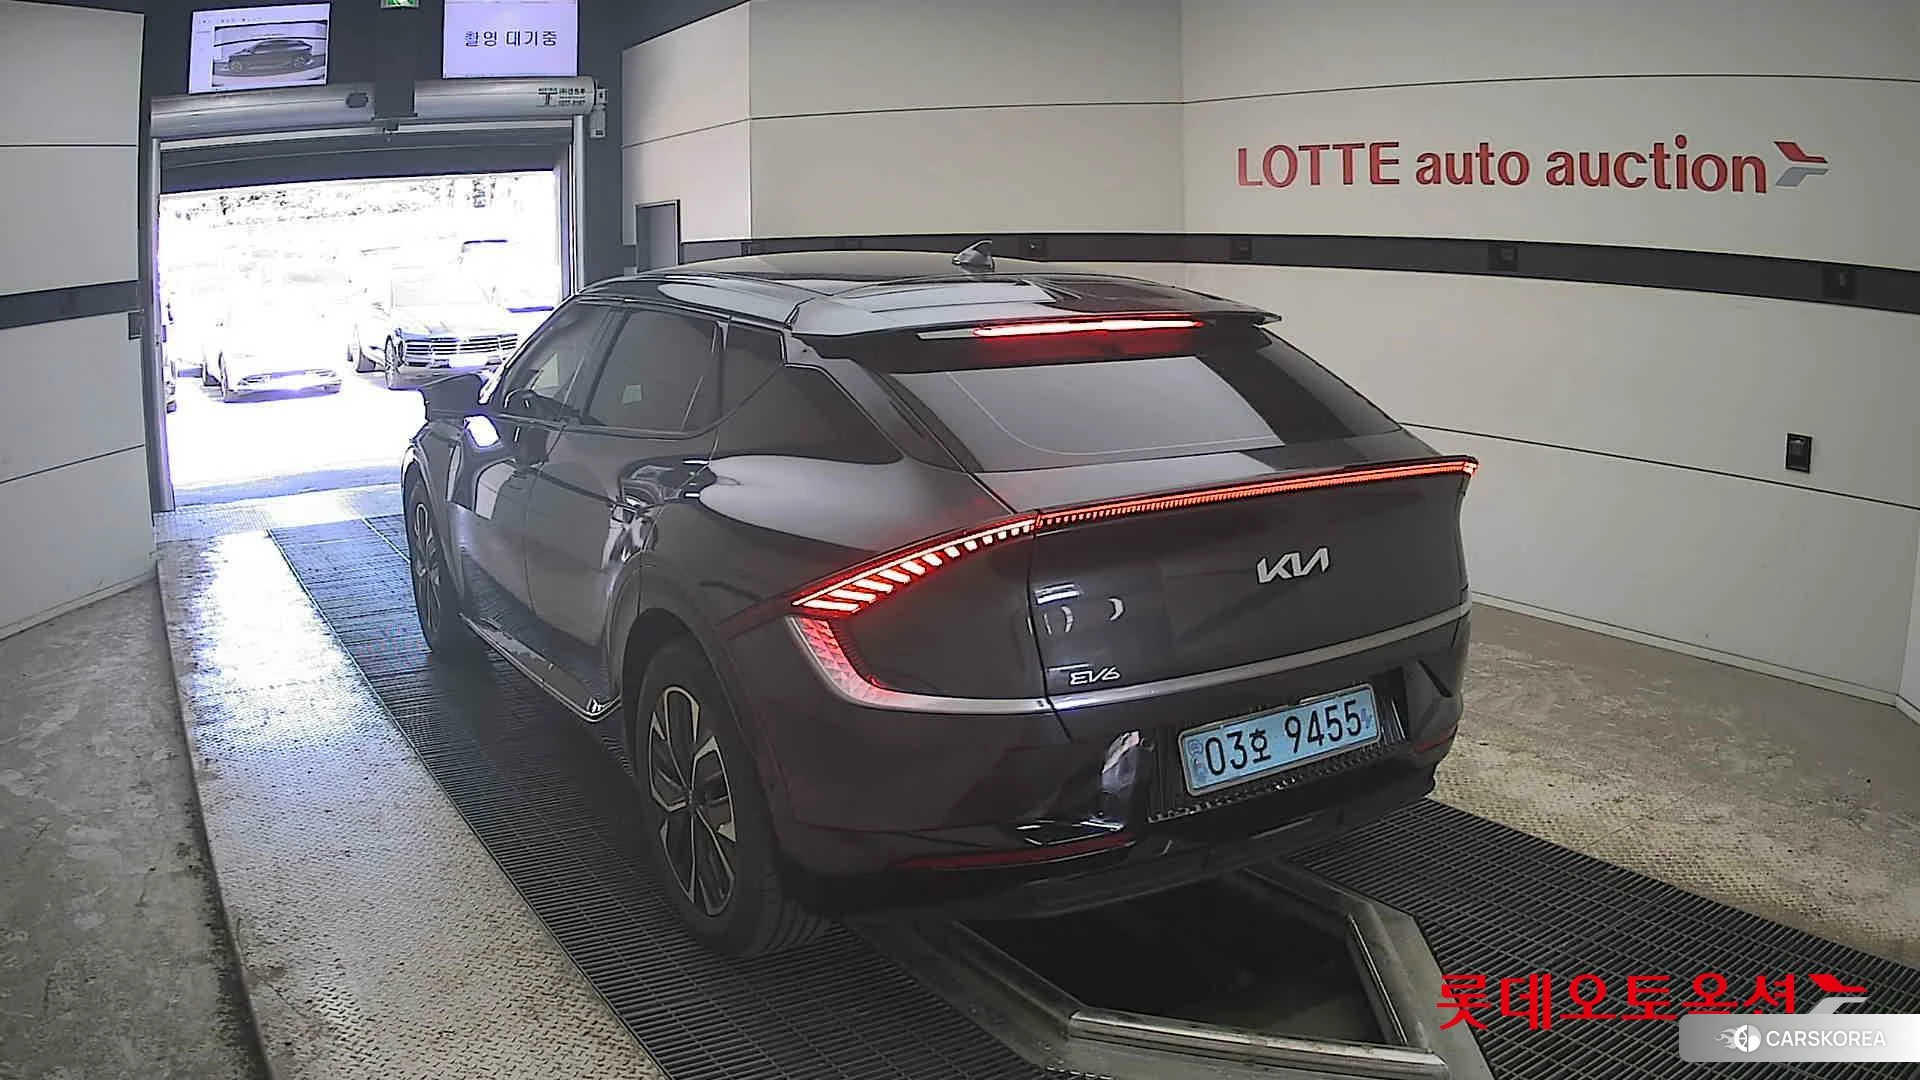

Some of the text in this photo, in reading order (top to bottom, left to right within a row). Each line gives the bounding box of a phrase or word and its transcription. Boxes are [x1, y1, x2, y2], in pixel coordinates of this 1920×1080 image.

[506, 31, 557, 46] 대기중
[1237, 134, 1768, 193] LOTTE auto auction
[1256, 547, 1330, 584] KIA
[1069, 667, 1122, 686] EV6
[1205, 700, 1363, 776] 03호 9455
